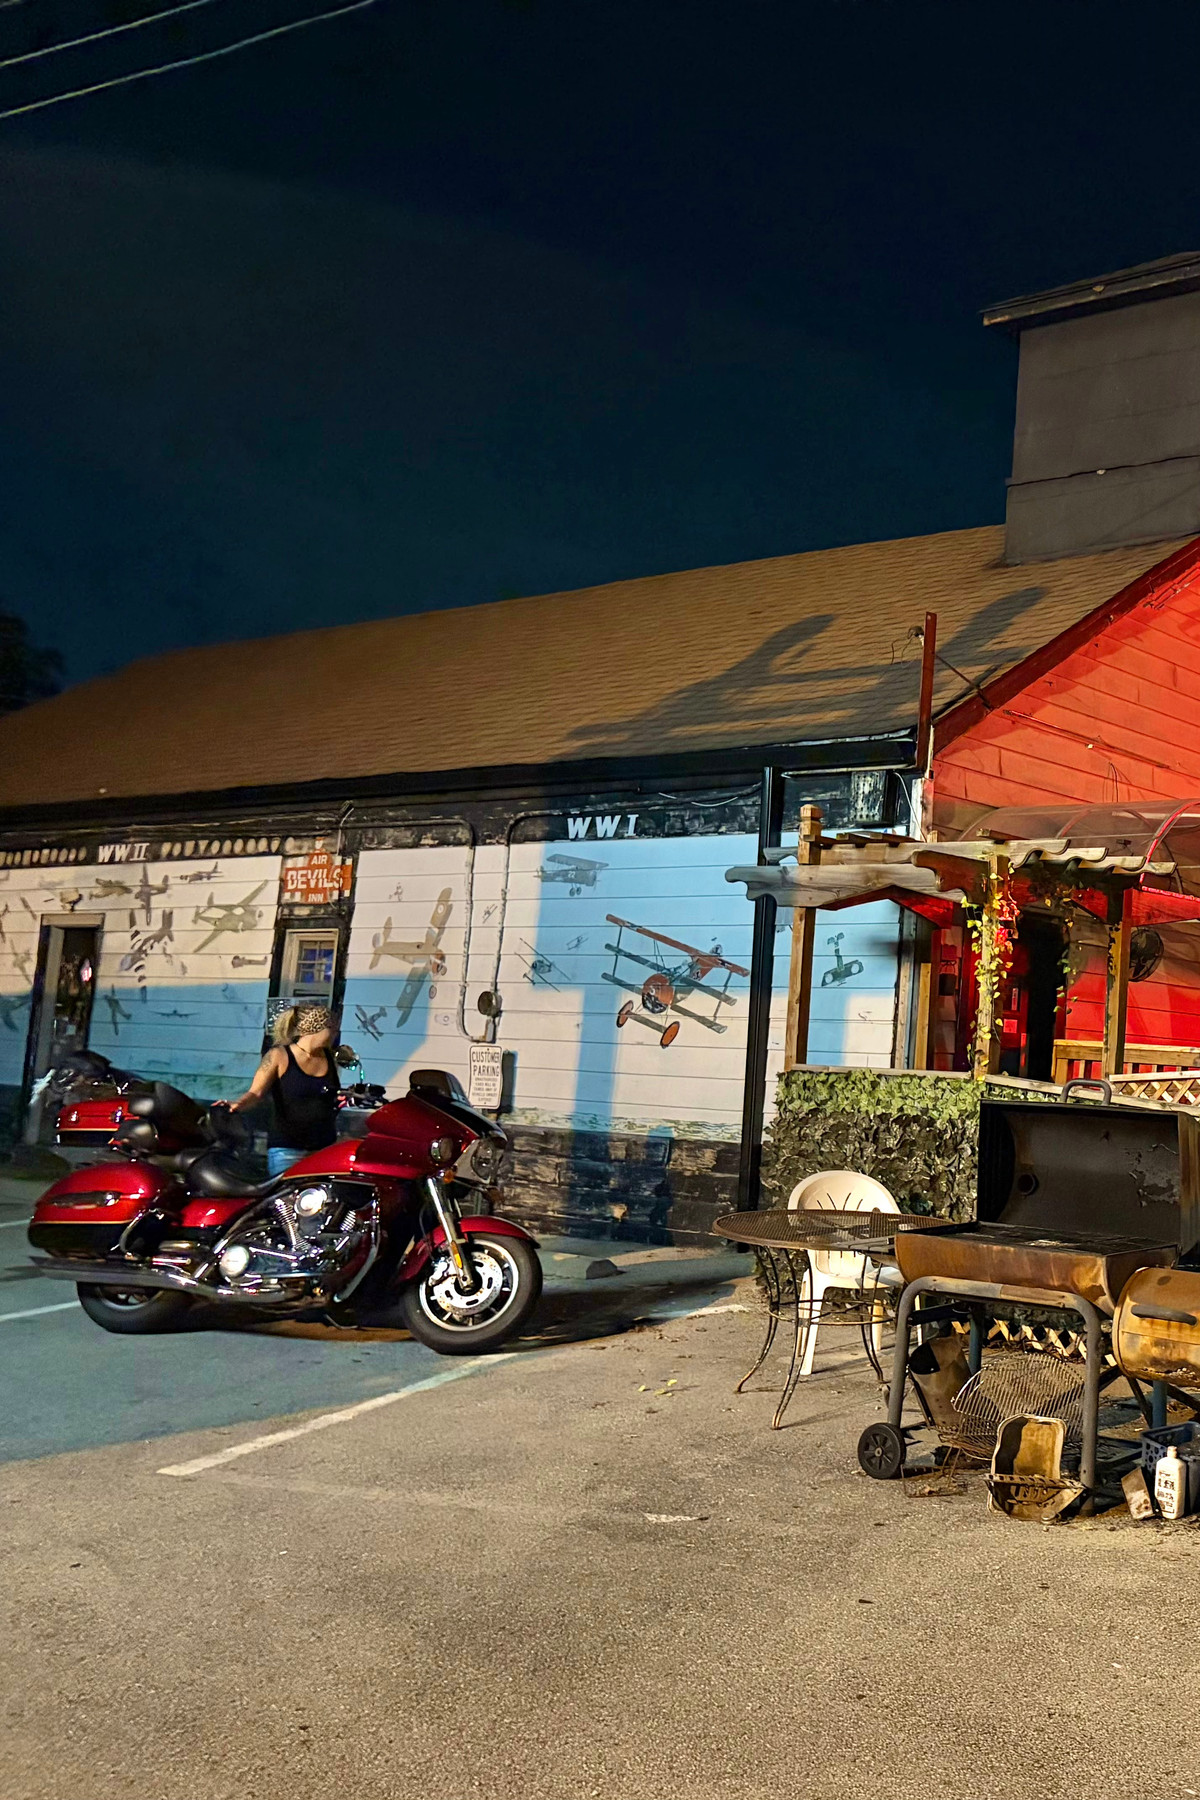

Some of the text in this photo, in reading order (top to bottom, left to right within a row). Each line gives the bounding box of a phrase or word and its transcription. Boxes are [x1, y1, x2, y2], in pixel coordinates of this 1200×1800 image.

[310, 854, 328, 865] AIR
[286, 868, 344, 890] DEVILS
[308, 893, 324, 903] INN
[472, 1051, 500, 1063] CUSTOMER
[473, 1065, 500, 1077] PARKING
